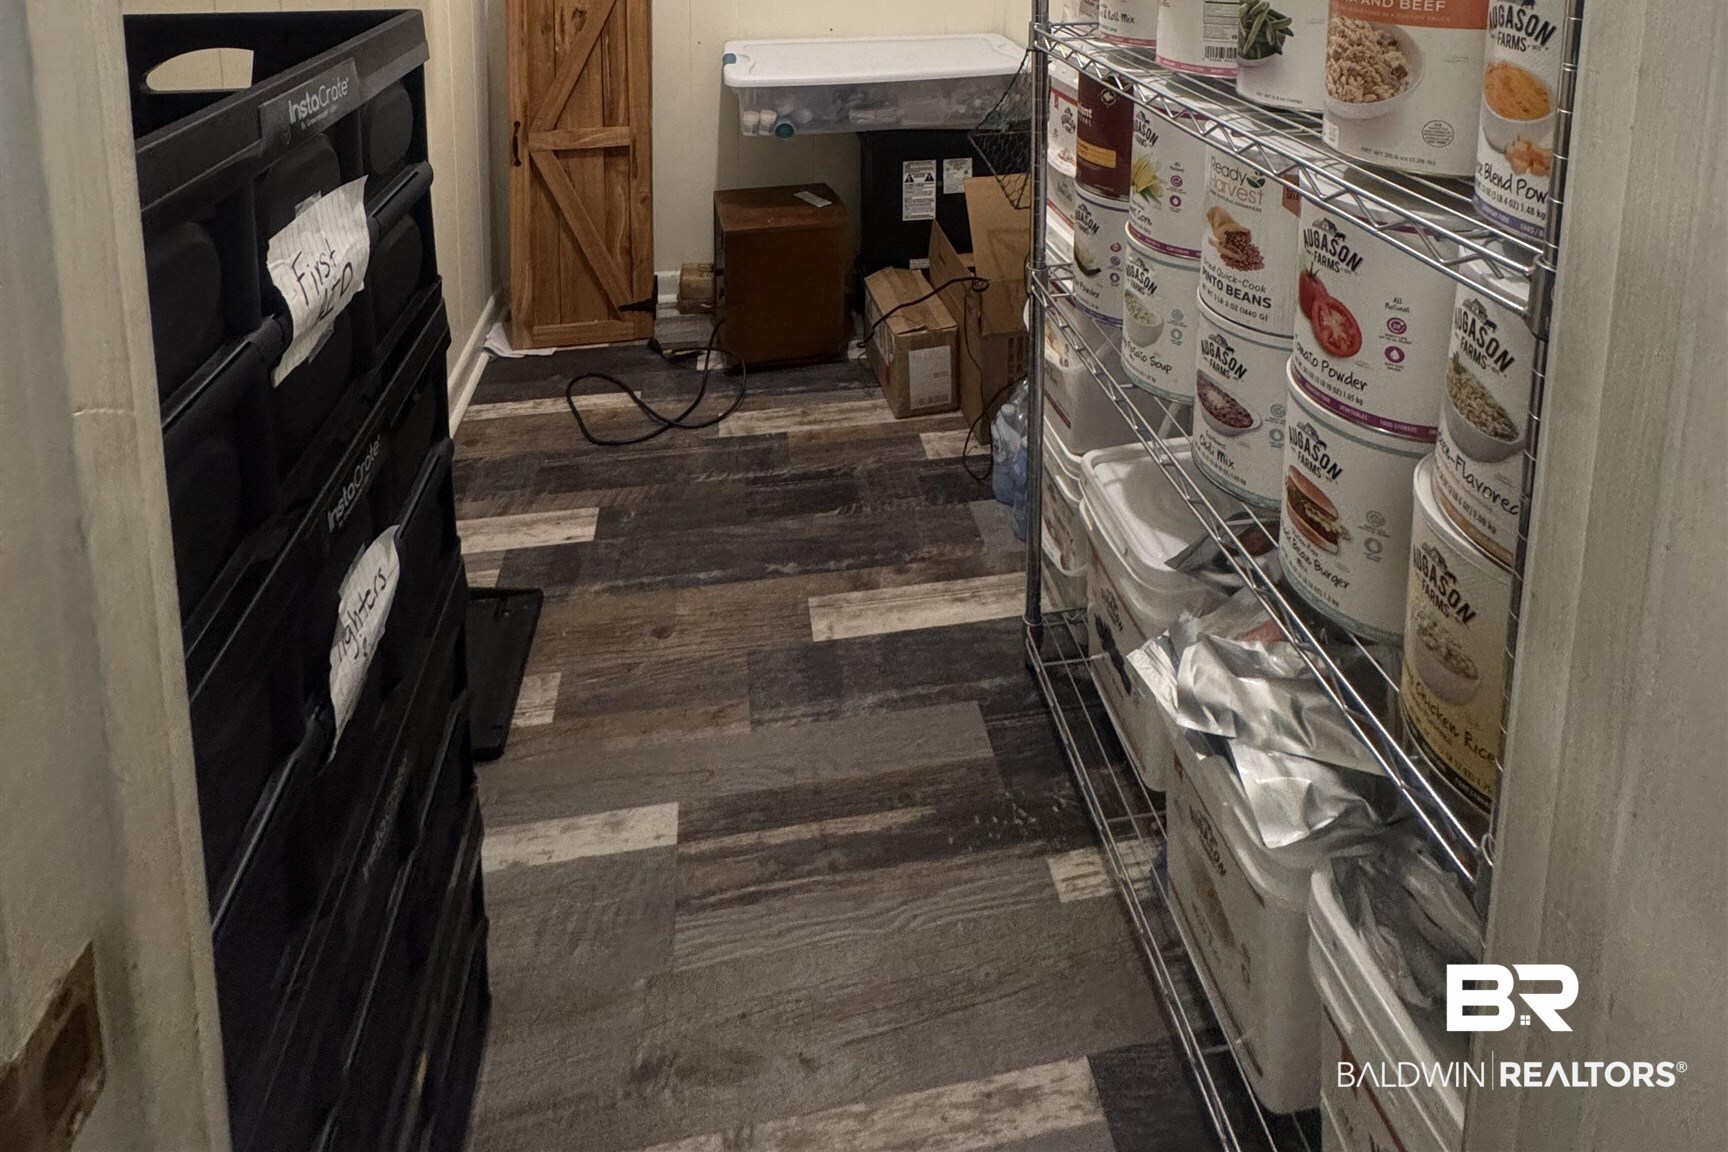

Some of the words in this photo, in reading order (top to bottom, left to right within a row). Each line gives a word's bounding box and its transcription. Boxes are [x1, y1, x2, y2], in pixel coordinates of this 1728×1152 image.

[1489, 4, 1557, 47] AUGASON
[1497, 31, 1527, 52] FARMS
[288, 77, 348, 125] InstaCrate
[1211, 156, 1247, 186] Ready
[1484, 163, 1513, 194] Blend
[1516, 179, 1548, 204] Pow
[1210, 176, 1265, 206] Harvest
[1536, 209, 1546, 221] kg
[1303, 228, 1364, 273] AUGASON
[1314, 250, 1340, 273] FARMS
[291, 237, 337, 307] First
[1202, 266, 1223, 291] PINTO
[1226, 284, 1272, 309] BEANS
[1216, 268, 1267, 294] Quick-Cook
[1385, 302, 1410, 313] Natural
[1126, 340, 1148, 363] Potato
[1149, 355, 1172, 374] Soup
[1201, 339, 1248, 380] AUGASON
[1209, 358, 1231, 380] FARMS
[1461, 335, 1487, 369] FARMS
[1321, 360, 1367, 391] Powder
[1217, 448, 1235, 471] Mix
[1288, 426, 1343, 481] AUGASON
[1297, 451, 1322, 479] FARMS
[327, 439, 380, 533] InstaCrate
[1313, 558, 1350, 589] Burger
[1422, 577, 1450, 618] FARMS
[1415, 681, 1460, 737] Chicken
[1463, 730, 1495, 762] Rice
